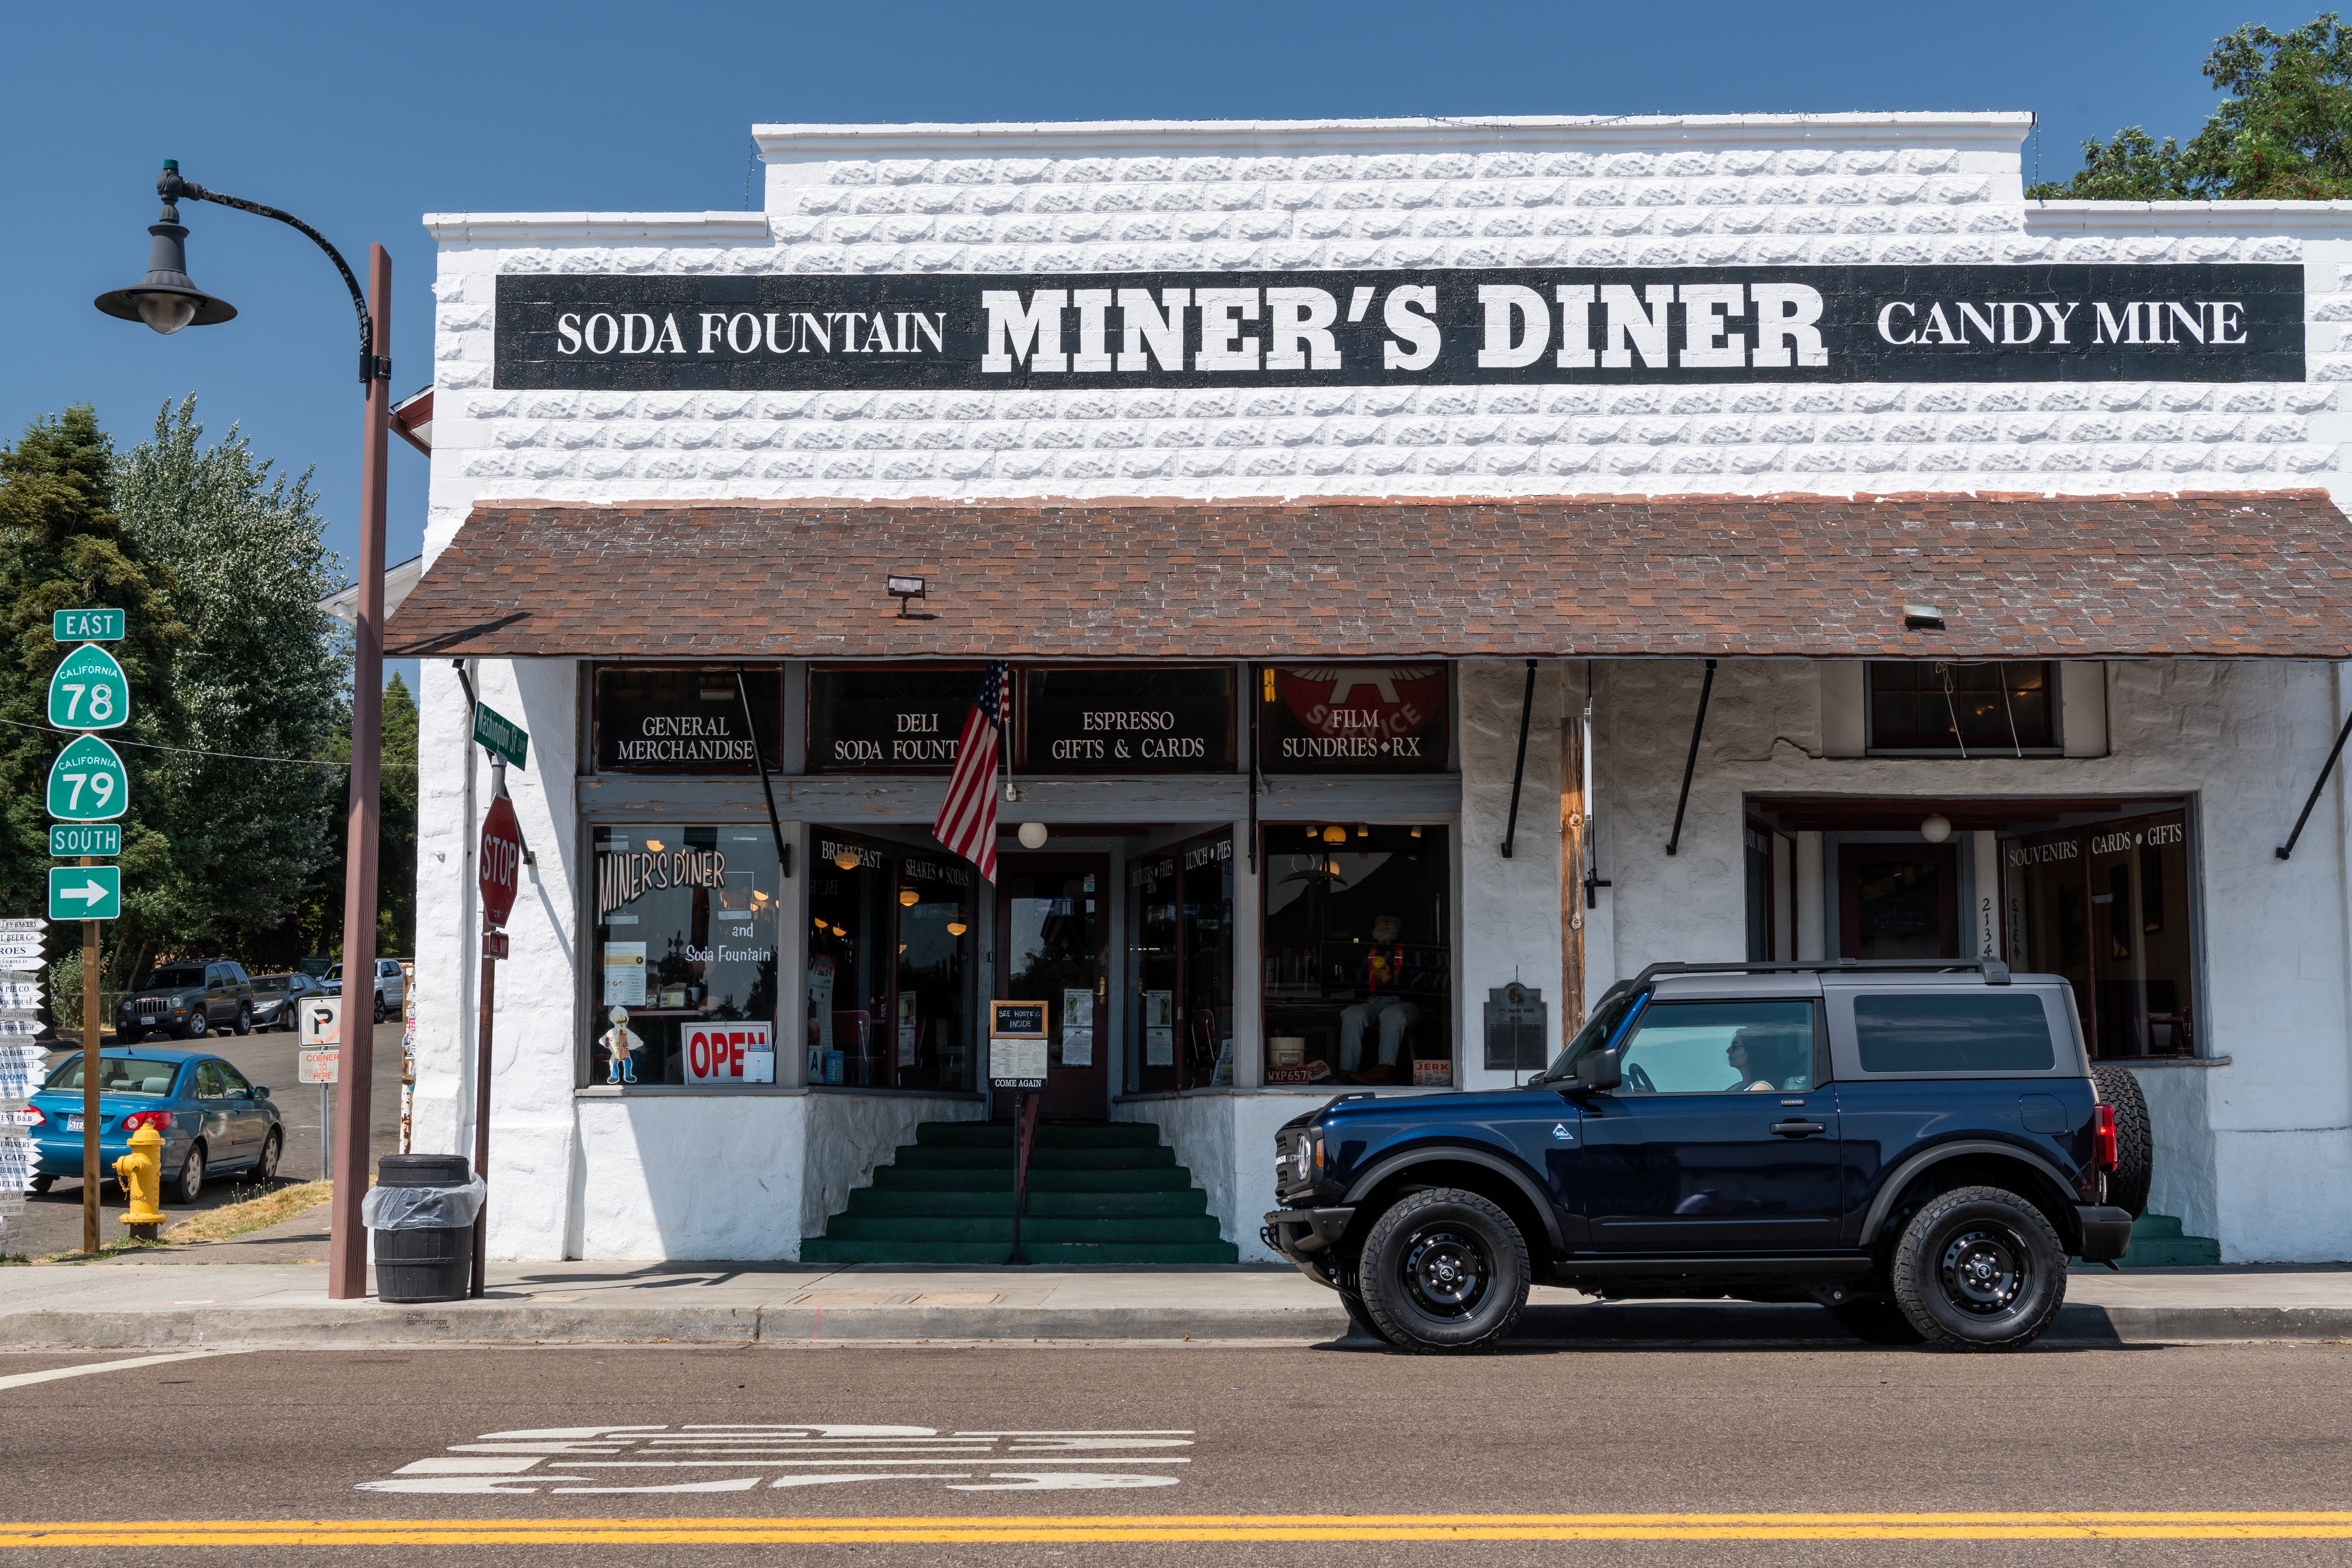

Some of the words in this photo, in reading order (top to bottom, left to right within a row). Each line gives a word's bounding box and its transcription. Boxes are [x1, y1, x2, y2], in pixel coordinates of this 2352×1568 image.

[557, 313, 686, 354] SODA
[697, 312, 947, 353] FOUNTAIN
[982, 285, 1441, 373] MINER'S
[1478, 283, 1828, 368] DINER
[1877, 302, 2080, 345] CANDY
[2092, 302, 2247, 344] MINE
[66, 615, 113, 635] EAST
[60, 665, 118, 679] CALIFORNIA
[61, 683, 113, 721] 78
[478, 704, 509, 751] Washington
[510, 727, 517, 755] St
[642, 717, 730, 736] GENERAL
[897, 713, 939, 732] DELI
[1083, 711, 1174, 731] ESPRESSO
[1306, 703, 1422, 740] SERVICE
[1333, 709, 1379, 729] FILM
[618, 740, 754, 760] MERCHANDISE
[835, 740, 884, 760] SODA
[893, 740, 959, 759] FOUNT
[1052, 740, 1104, 759] GIFTS
[1114, 739, 1131, 758] &
[1142, 737, 1204, 757] CARDS
[1282, 737, 1377, 757] SUNDRIES
[1392, 737, 1421, 757] RX
[59, 757, 117, 771] CALIFORNIA
[62, 771, 114, 811] 79
[54, 831, 116, 850] SOUTH
[2009, 840, 2078, 868] SOUVENIRS
[2092, 832, 2131, 856] CARDS
[2147, 823, 2183, 847] GIFTS
[482, 834, 517, 887] STOP
[821, 840, 883, 870] BREAKFAST
[1185, 846, 1208, 870] LUNCH
[1217, 839, 1231, 861] PIES
[905, 858, 937, 881] SHAKES
[946, 866, 970, 888] SODAS
[1133, 865, 1154, 887] BURGERS
[1159, 859, 1173, 879] FRIES
[597, 851, 668, 926] MINER'S
[673, 850, 725, 889] DINER
[732, 923, 753, 938] and
[1982, 898, 1992, 956] 2134
[685, 944, 714, 962] Soda
[718, 945, 770, 962] Fountain
[811, 1052, 818, 1071] A
[1267, 1070, 1307, 1081] WXP657
[8, 1192, 21, 1200] CROSS
